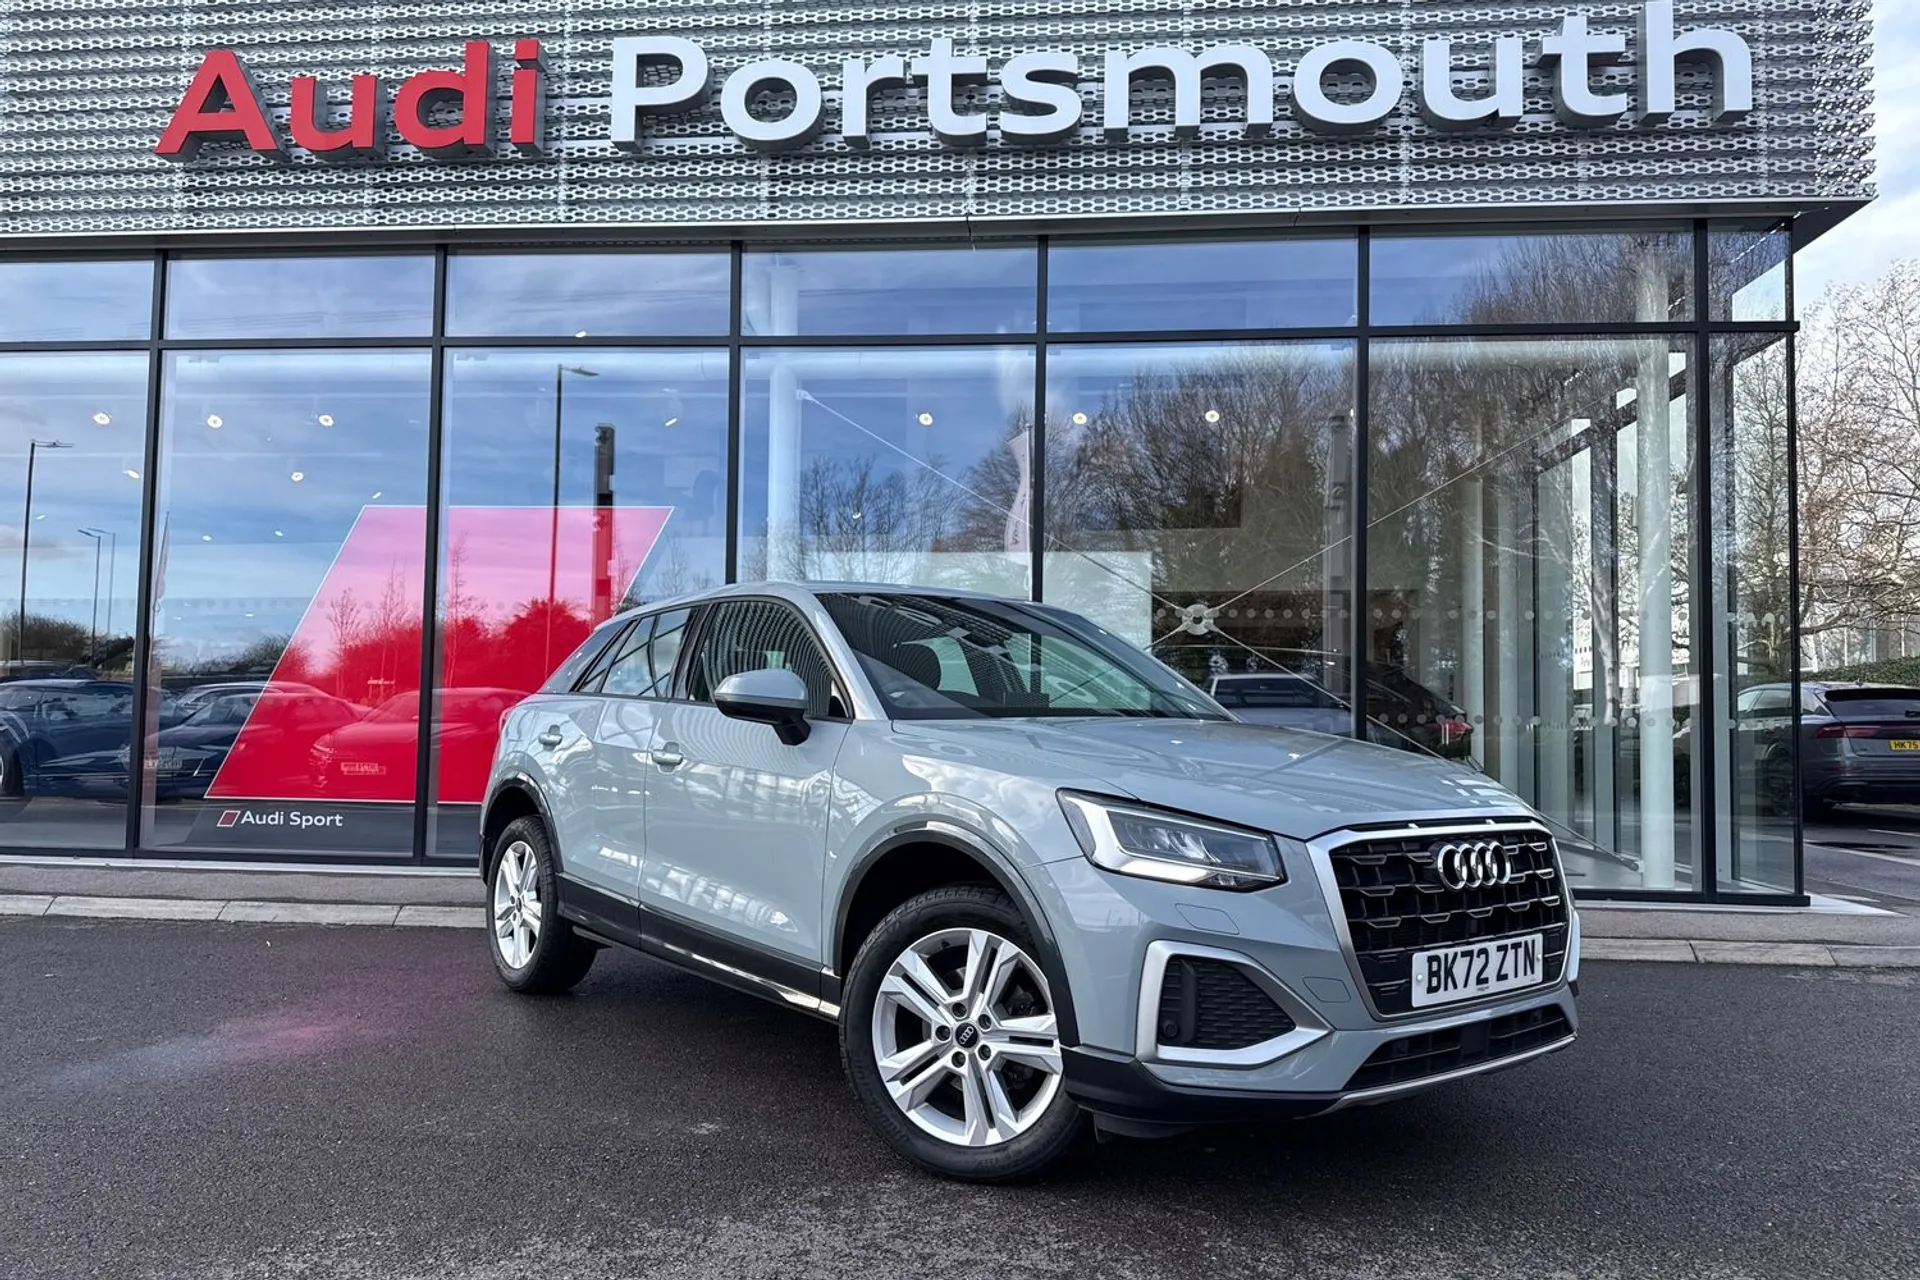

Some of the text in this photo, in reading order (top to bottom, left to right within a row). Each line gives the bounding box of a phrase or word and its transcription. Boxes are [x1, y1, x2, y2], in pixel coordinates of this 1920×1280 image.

[154, 0, 1753, 156] Audi Portsmouth
[240, 811, 344, 829] Audi Sport
[1426, 939, 1536, 995] BK72 ZTN
